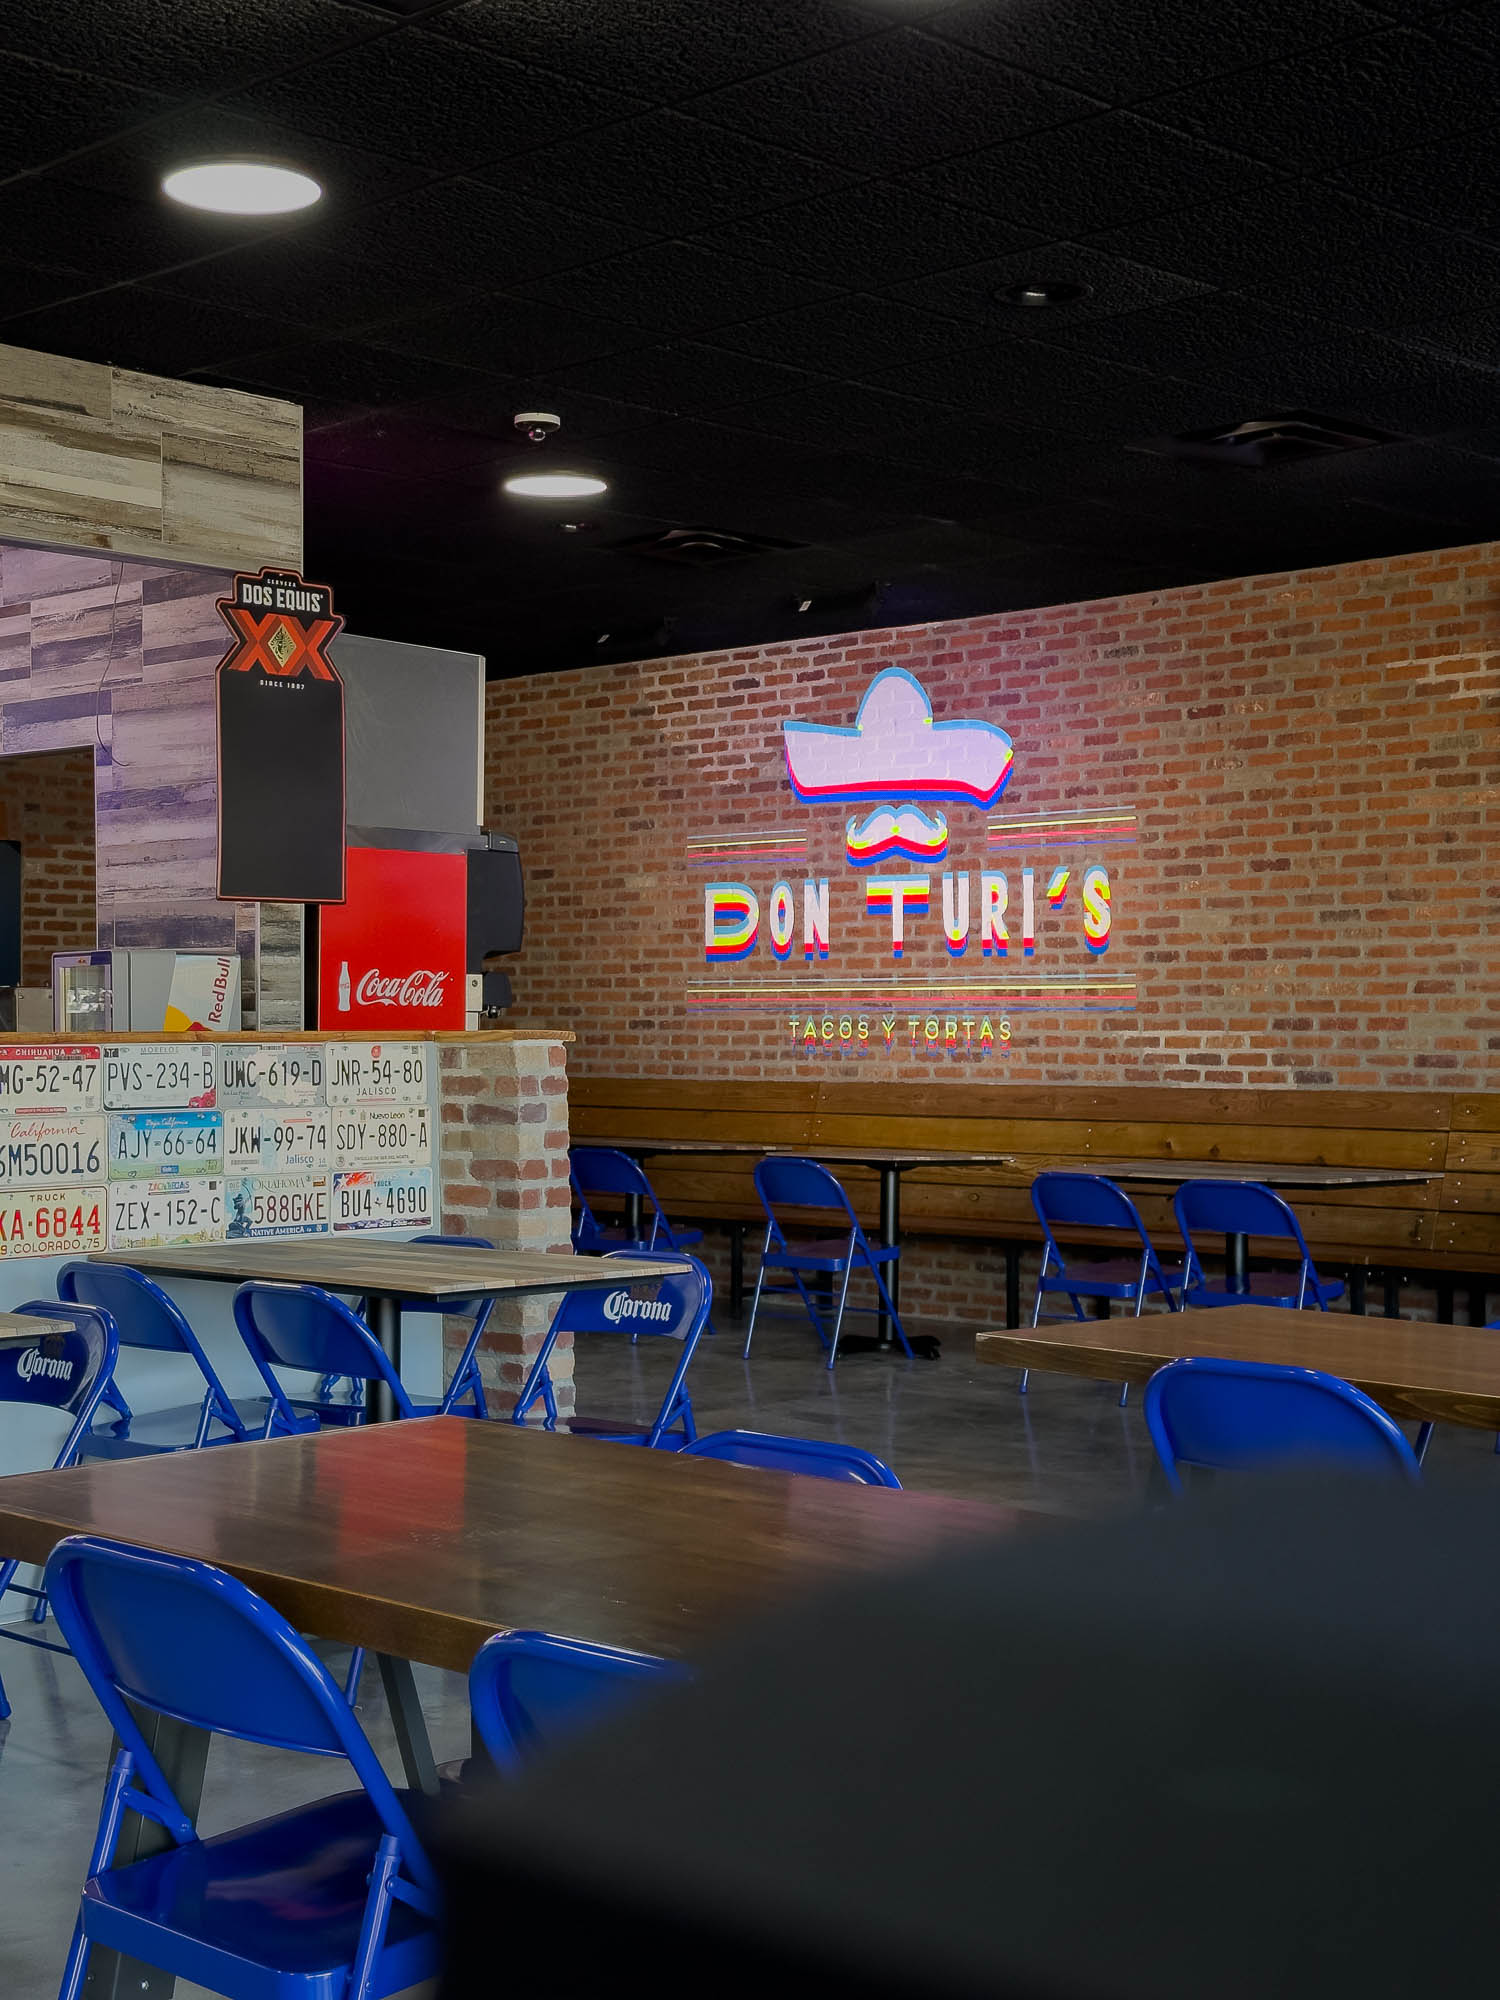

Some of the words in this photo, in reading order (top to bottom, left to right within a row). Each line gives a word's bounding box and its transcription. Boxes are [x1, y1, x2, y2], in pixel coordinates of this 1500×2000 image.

[267, 578, 297, 587] CERVEZA
[242, 583, 273, 606] DOS
[276, 587, 321, 613] EQUIS
[227, 607, 336, 682] XX
[260, 679, 284, 688] SINCE
[705, 877, 830, 963] DON
[866, 865, 1112, 957] TURI'S
[213, 957, 231, 990] Bull
[356, 968, 450, 1007] Coca-Cola
[208, 990, 226, 1023] Red
[789, 1016, 869, 1050] TACOS
[882, 1016, 896, 1050] Y
[909, 1016, 1012, 1050] TORTAS
[15, 1048, 66, 1056] CHIHUAHUA
[107, 1061, 213, 1091] PVS-234-B
[224, 1059, 322, 1088] UWC-619-D
[331, 1059, 423, 1086] JNR-54-80
[356, 1086, 397, 1096] JALISCO
[369, 1111, 389, 1120] Nuevo
[10, 1120, 86, 1142] California
[117, 1128, 217, 1160] AJY-66-64
[229, 1124, 327, 1155] JKW-99-74
[336, 1122, 428, 1151] SDY-880-A
[285, 1154, 314, 1165] Jalisco
[29, 1192, 66, 1202] TRUCK
[251, 1176, 305, 1192] OKLAHOMA
[115, 1196, 221, 1231] ZEX-152-C
[253, 1192, 327, 1224] 588GKE
[341, 1188, 372, 1218] BU4
[386, 1186, 427, 1215] 4690
[13, 1239, 81, 1254] COLORADO
[87, 1237, 100, 1249] 75
[251, 1226, 276, 1237] NATIVE
[277, 1225, 305, 1236] AMERICA
[603, 1290, 673, 1324] Corona
[17, 1347, 74, 1382] Corona
